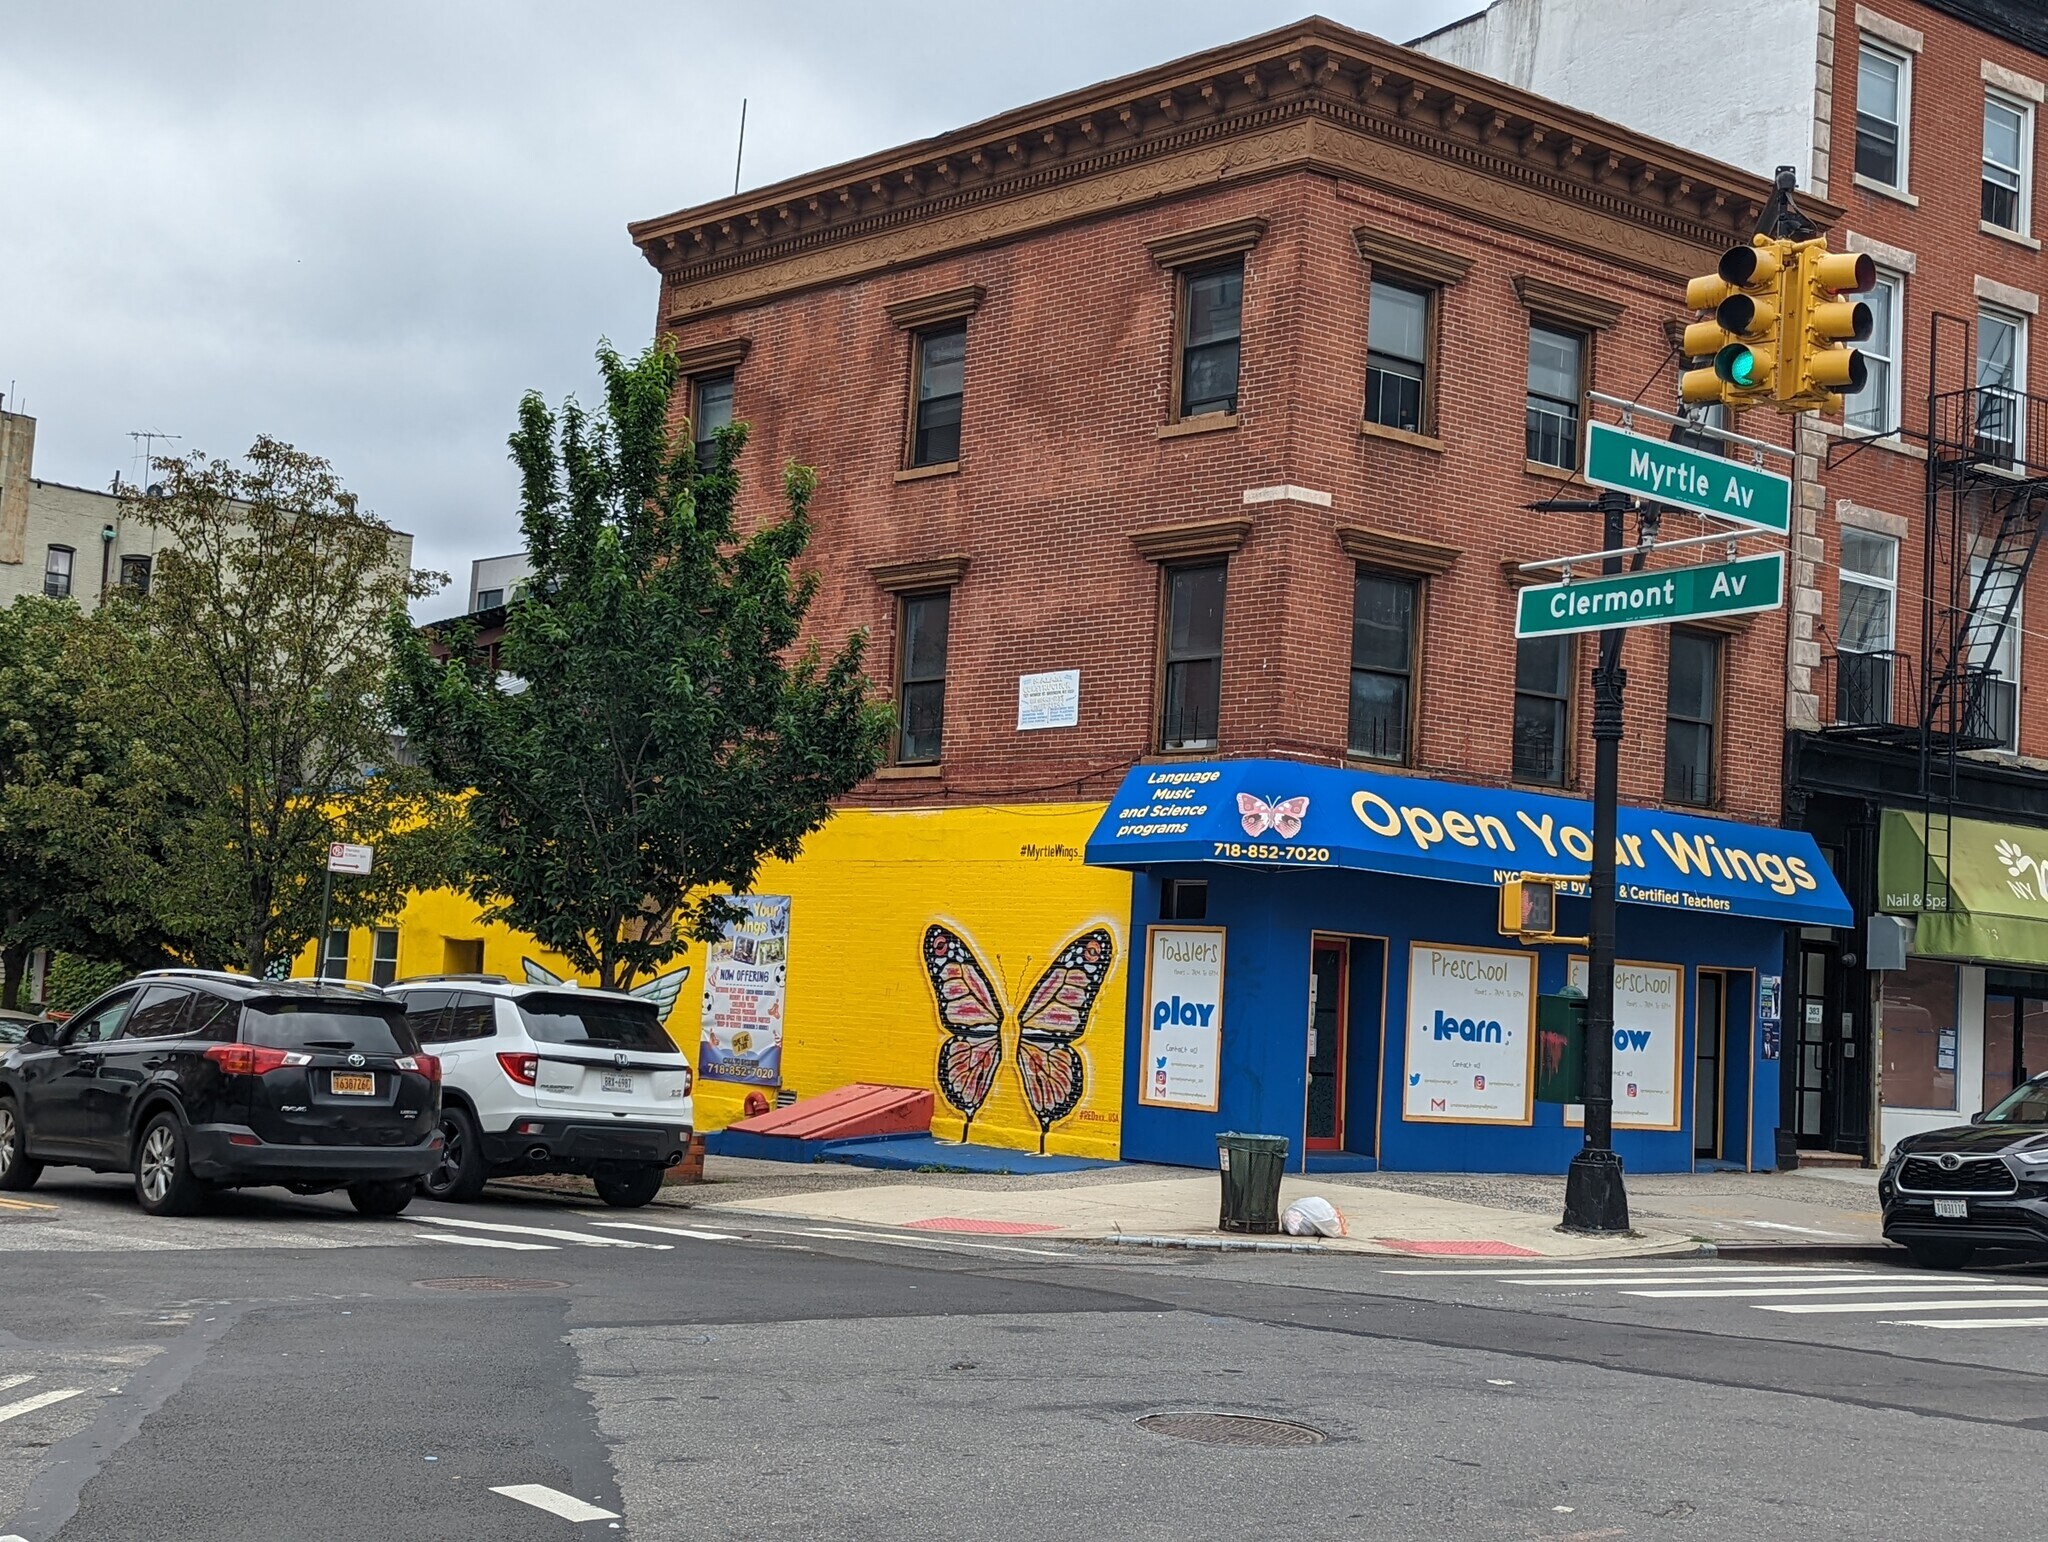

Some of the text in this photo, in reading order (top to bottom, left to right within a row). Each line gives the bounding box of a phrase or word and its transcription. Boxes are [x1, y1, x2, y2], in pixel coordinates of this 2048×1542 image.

[1630, 448, 1755, 509] Myrtle Av
[1550, 571, 1747, 618] Clermont Av
[1148, 770, 1220, 785] Language
[1152, 786, 1195, 800] Music
[1119, 803, 1207, 818] and Science
[1116, 822, 1188, 838] programs
[1214, 842, 1330, 862] 718-852-7020
[1351, 790, 1516, 851] Open
[1650, 828, 1818, 896] Wings
[1571, 880, 1586, 895] by
[1619, 885, 1628, 898] &
[1630, 886, 1679, 905] Certified
[1682, 892, 1730, 910] Teachers
[2006, 880, 2036, 901] NY
[753, 901, 780, 918] Your
[1886, 894, 1948, 910] Nail & Spa
[1160, 937, 1218, 963] Toddlers
[720, 969, 770, 982] NOW OFFERING
[1153, 996, 1215, 1030] play
[1808, 1007, 1820, 1016] 383
[1434, 1010, 1502, 1044] learn
[1166, 1043, 1187, 1054] Contact
[1614, 1029, 1652, 1052] ow
[1452, 1060, 1472, 1068] Contact
